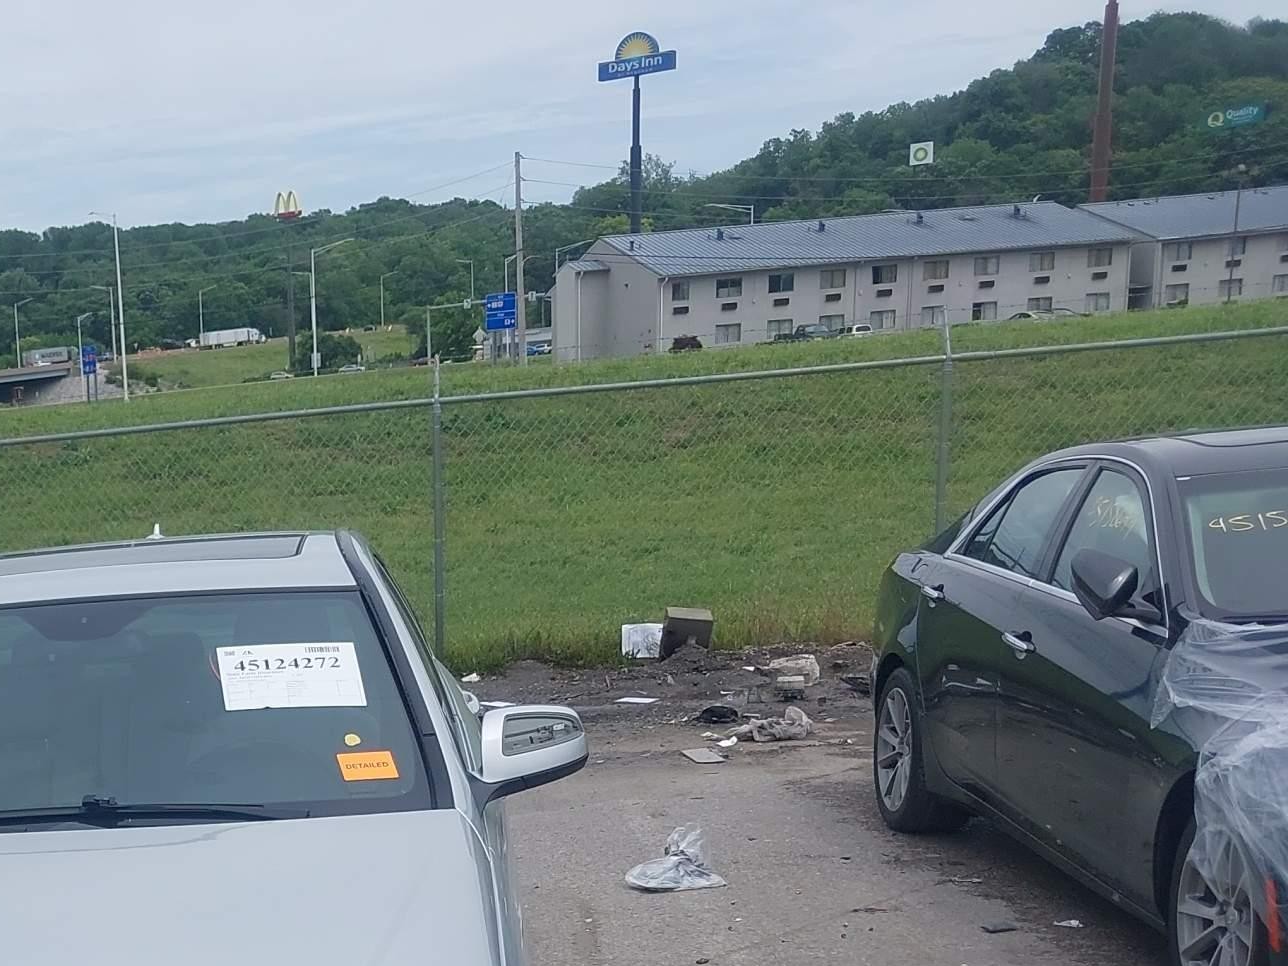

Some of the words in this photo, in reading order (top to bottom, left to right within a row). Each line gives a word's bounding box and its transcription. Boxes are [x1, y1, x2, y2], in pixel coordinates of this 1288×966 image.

[608, 60, 639, 73] Days
[641, 55, 663, 68] Inn
[1226, 106, 1259, 120] Quality
[234, 656, 341, 671] 45124272
[345, 761, 390, 770] DETAILED
